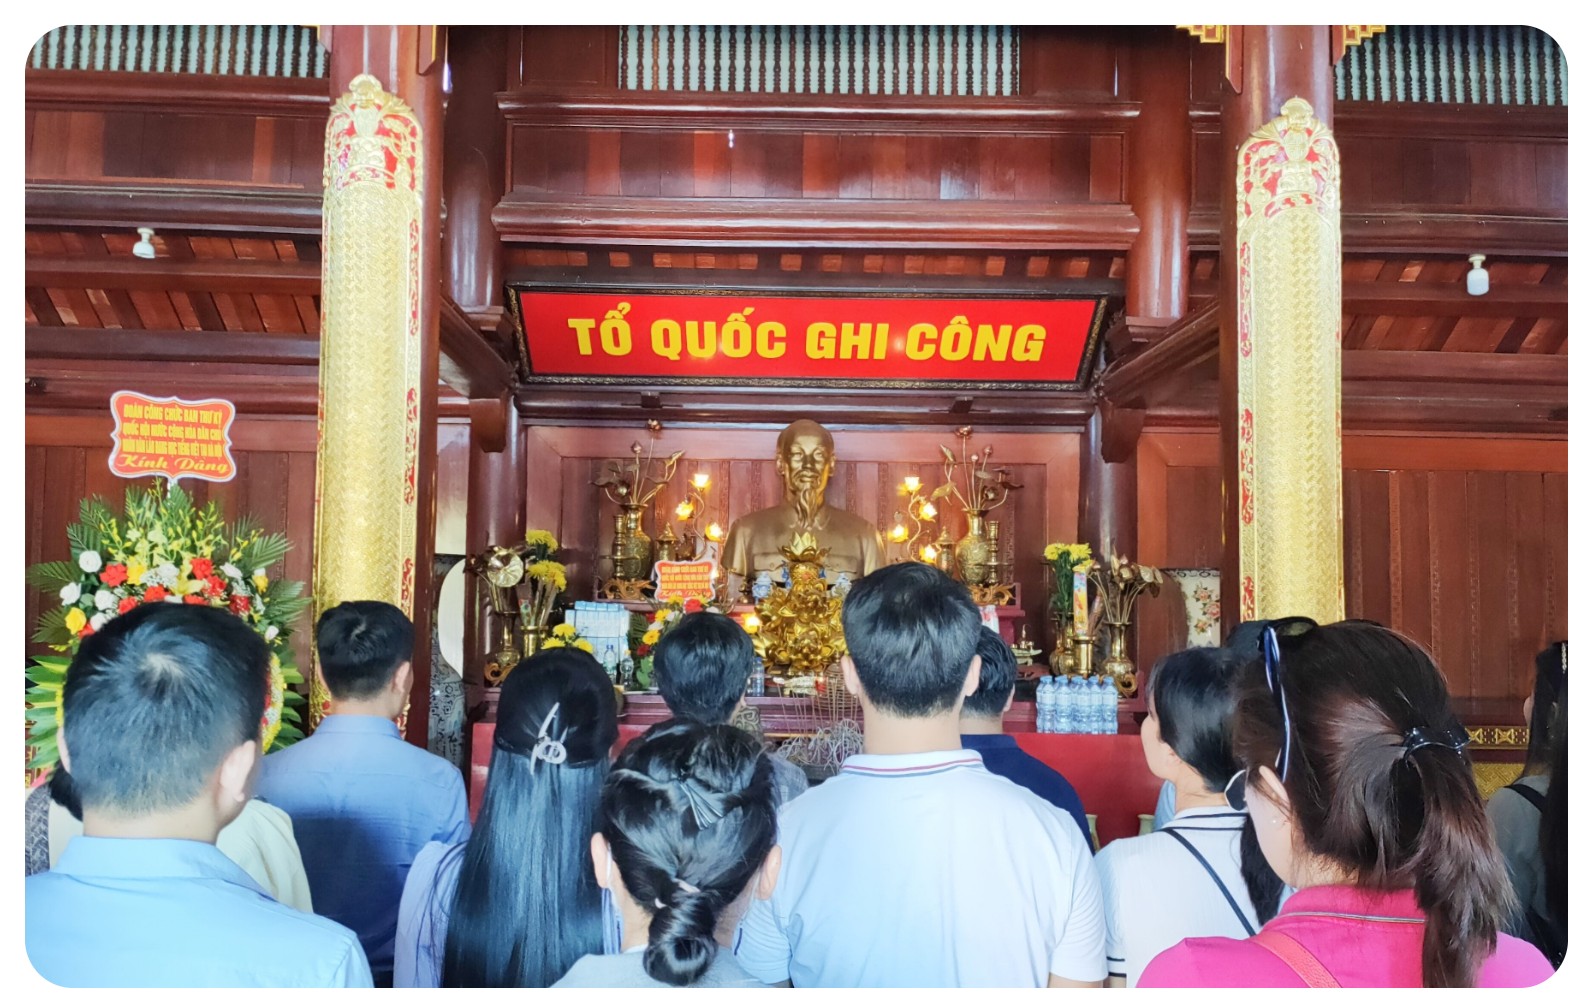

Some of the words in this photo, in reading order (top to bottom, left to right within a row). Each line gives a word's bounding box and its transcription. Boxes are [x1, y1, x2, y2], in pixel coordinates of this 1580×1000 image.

[568, 302, 632, 356] TỔ
[650, 307, 786, 360] QUỐC
[805, 320, 888, 360] GHI
[904, 315, 1047, 362] CÔNG
[118, 454, 168, 469] Kính
[174, 458, 228, 474] Dâng
